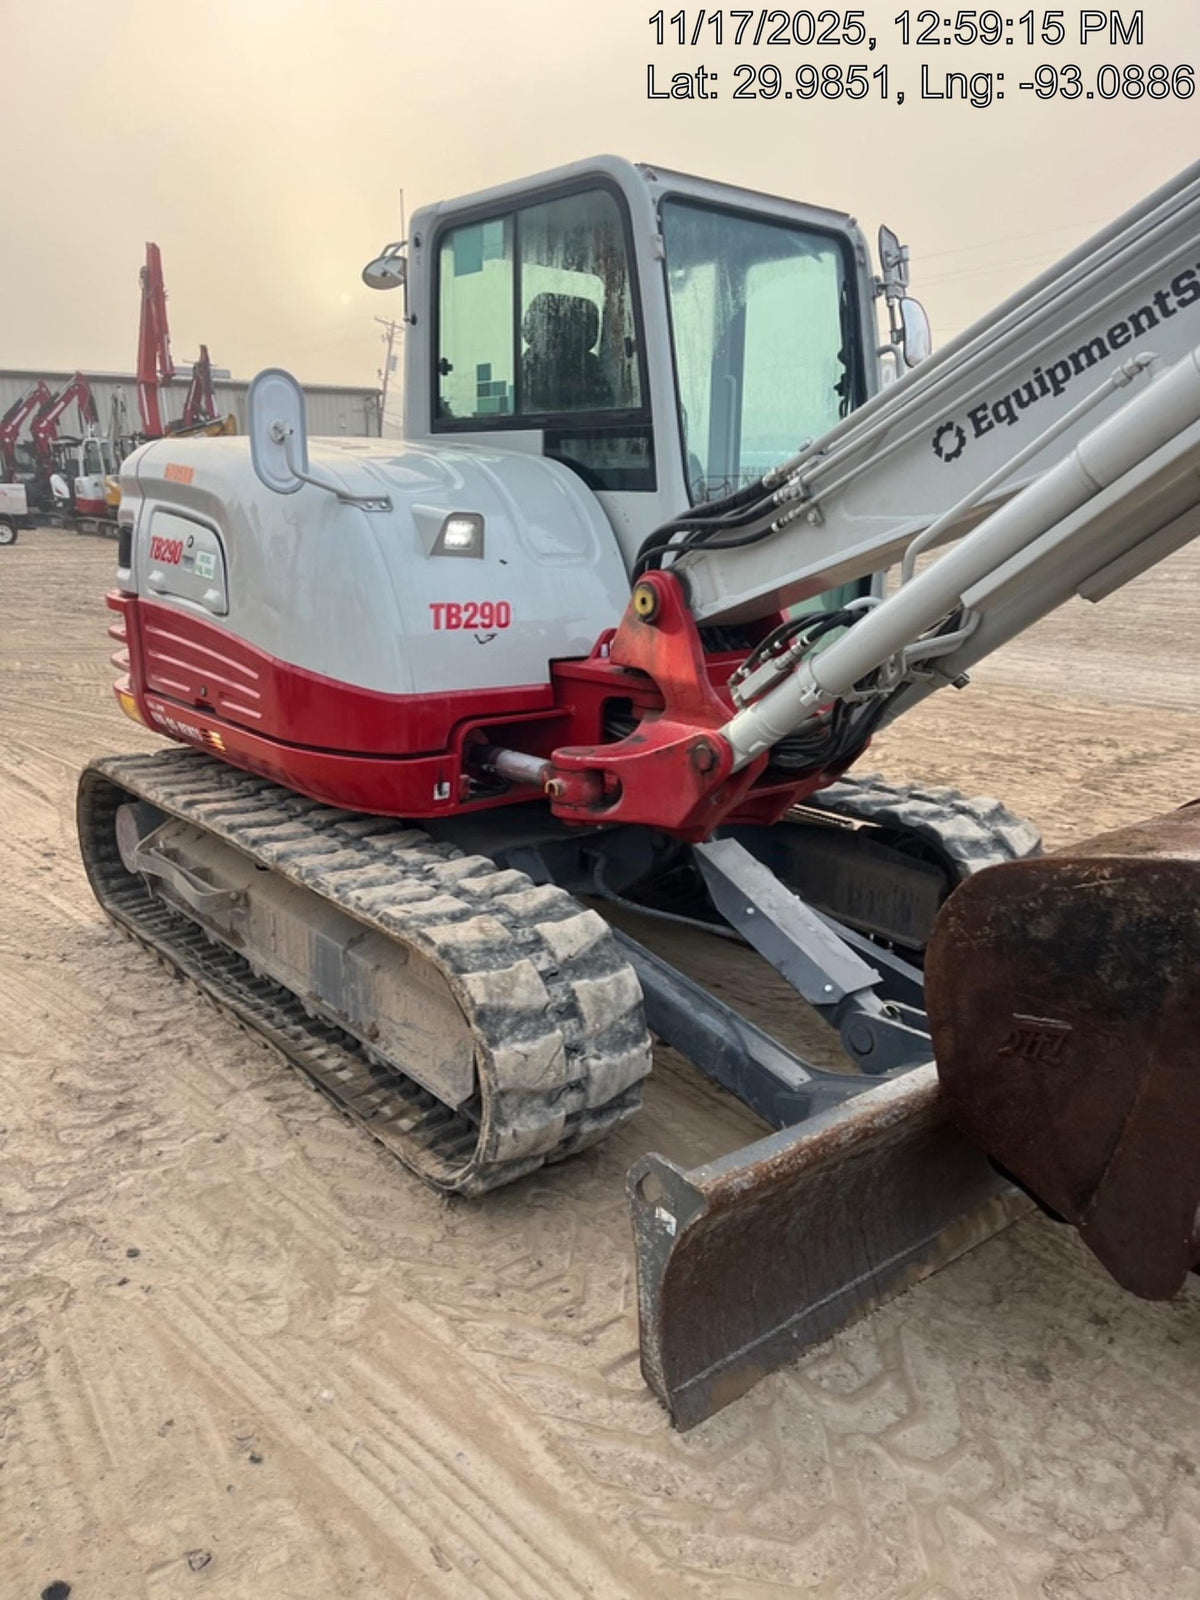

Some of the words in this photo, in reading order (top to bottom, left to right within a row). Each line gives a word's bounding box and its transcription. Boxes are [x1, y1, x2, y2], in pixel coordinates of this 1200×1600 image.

[967, 262, 1200, 438] EquipmentS
[149, 536, 183, 565] TB290
[429, 601, 511, 630] TB290
